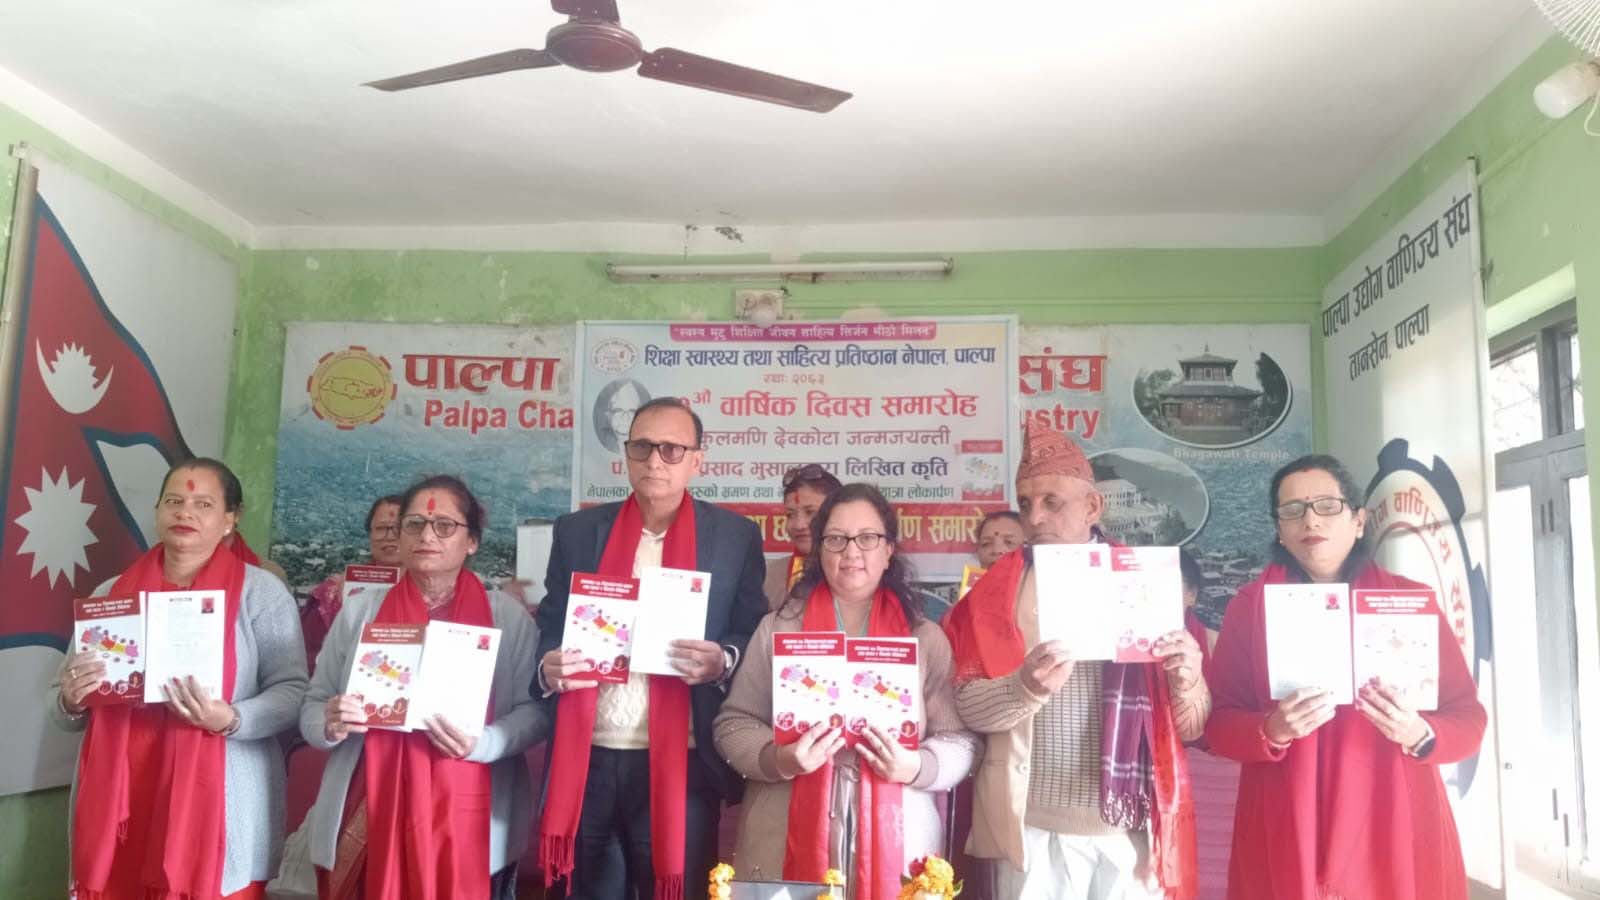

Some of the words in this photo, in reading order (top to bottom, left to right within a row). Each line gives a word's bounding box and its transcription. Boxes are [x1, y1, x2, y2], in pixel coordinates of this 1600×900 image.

[1322, 292, 1350, 337] पाल्पा
[1353, 266, 1384, 317] उद्योग
[1387, 233, 1440, 291] वाणिज्य
[1443, 193, 1472, 249] संघ
[1395, 303, 1431, 349] पाल्पा
[402, 354, 561, 393] पाल्पा
[1018, 346, 1108, 395] संघ
[644, 344, 680, 366] शिक्षा
[686, 349, 738, 366] स्वास्थ्य
[744, 349, 771, 366] तथा
[777, 344, 830, 367] साहित्य
[836, 343, 899, 368] प्रतिष्ठान
[955, 347, 996, 364] पाल्पा
[424, 400, 508, 434] Palpa
[719, 390, 798, 417] वार्षिक
[806, 390, 873, 417] दिवस
[881, 388, 979, 417] समारोह
[773, 426, 840, 448] देवकोटा
[846, 425, 951, 446] जन्मजयन्ती
[845, 456, 905, 477] लिखित
[911, 456, 949, 480] कृति
